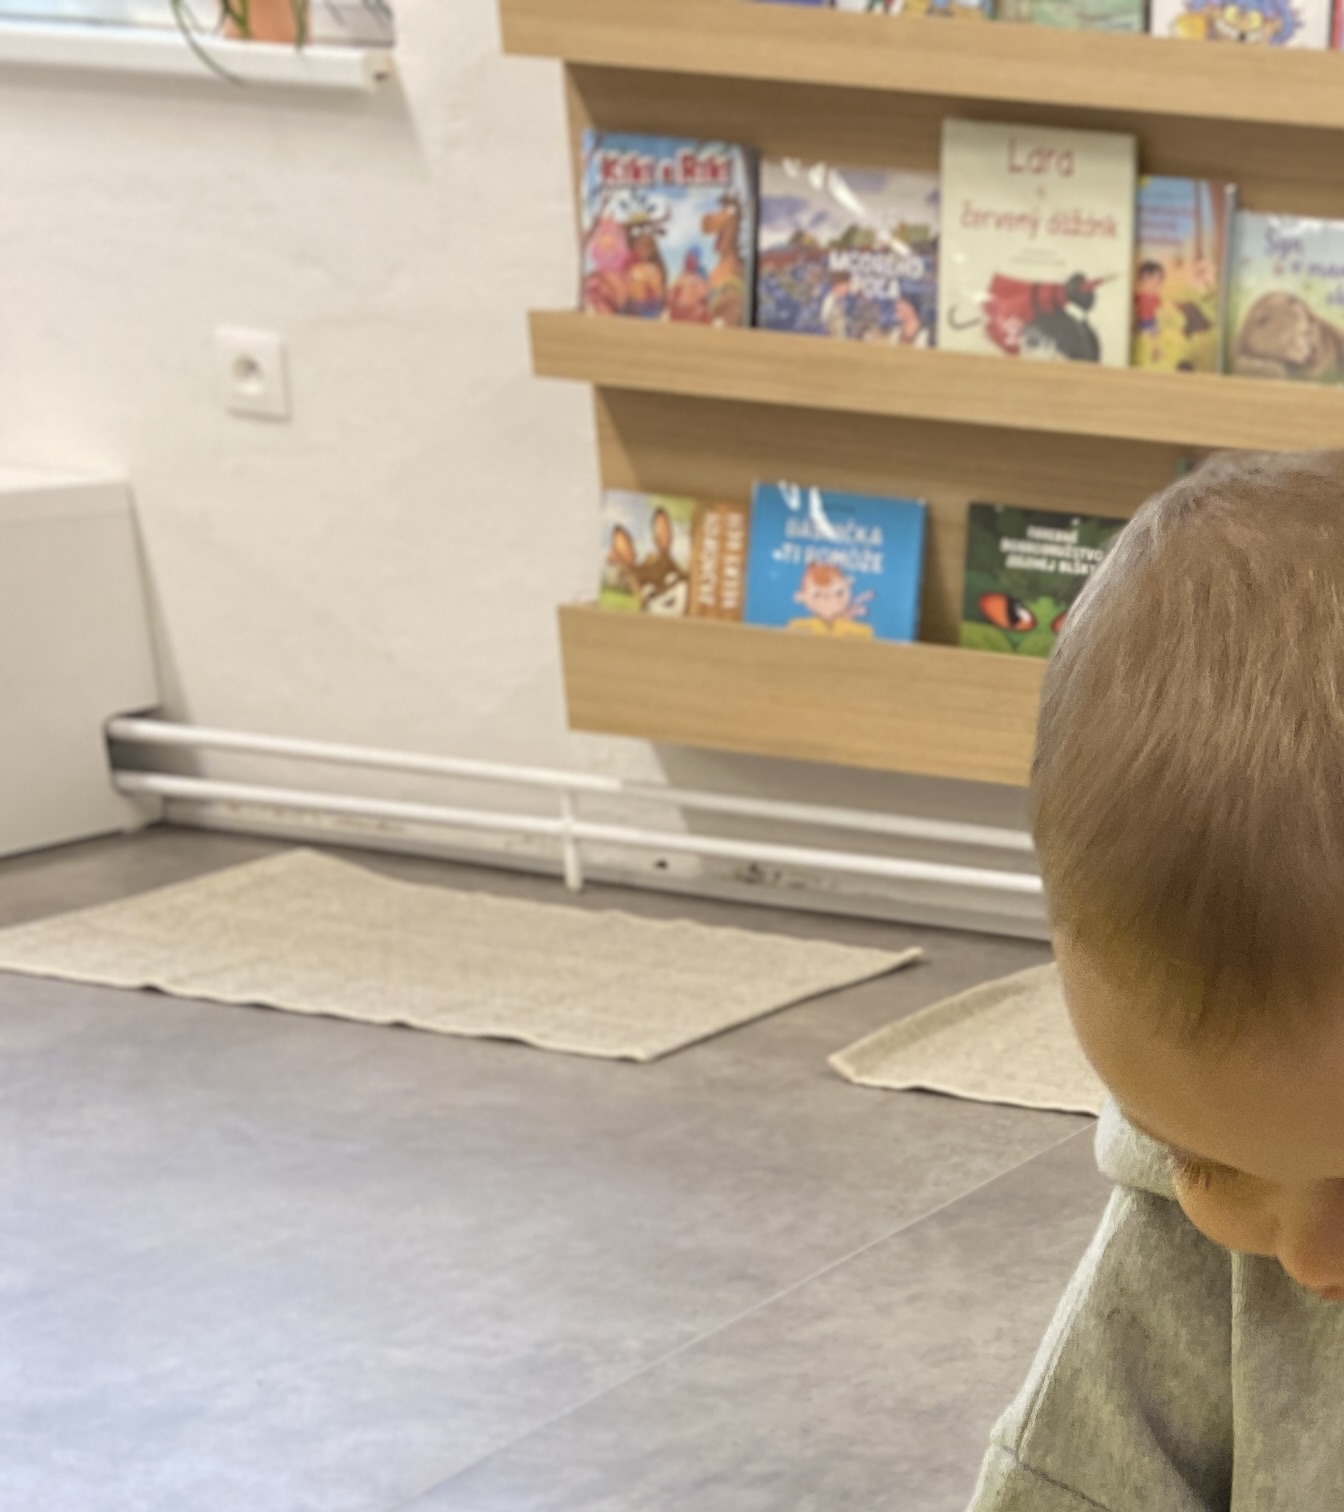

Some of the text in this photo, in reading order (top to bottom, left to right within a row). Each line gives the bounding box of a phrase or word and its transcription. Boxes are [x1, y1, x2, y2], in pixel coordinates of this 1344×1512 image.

[599, 151, 655, 185] Kiki
[677, 150, 732, 185] Riki
[1008, 136, 1073, 176] Lara
[960, 201, 1039, 241] červený
